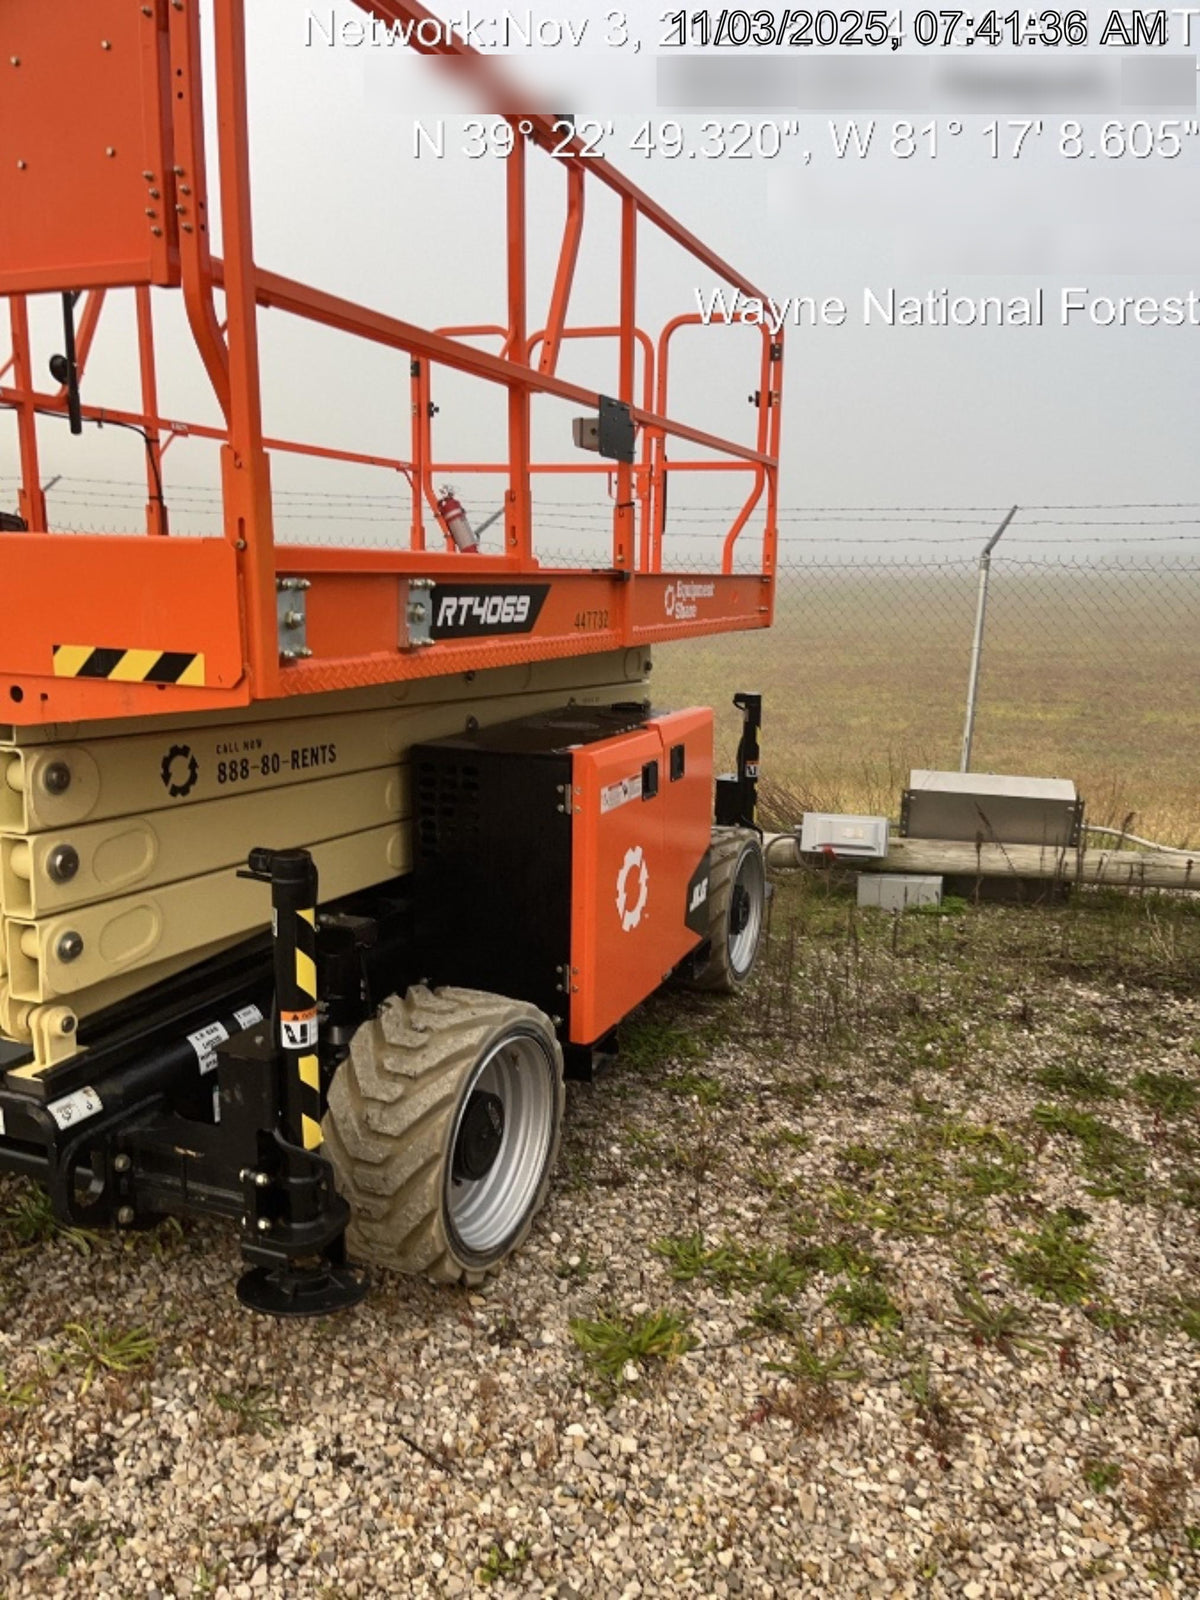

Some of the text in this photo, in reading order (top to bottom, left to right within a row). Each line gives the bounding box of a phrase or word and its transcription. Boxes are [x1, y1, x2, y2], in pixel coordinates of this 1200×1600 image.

[437, 595, 531, 627] RT4069
[216, 738, 262, 755] CALL NOW
[217, 743, 337, 784] 888-80-RENTS
